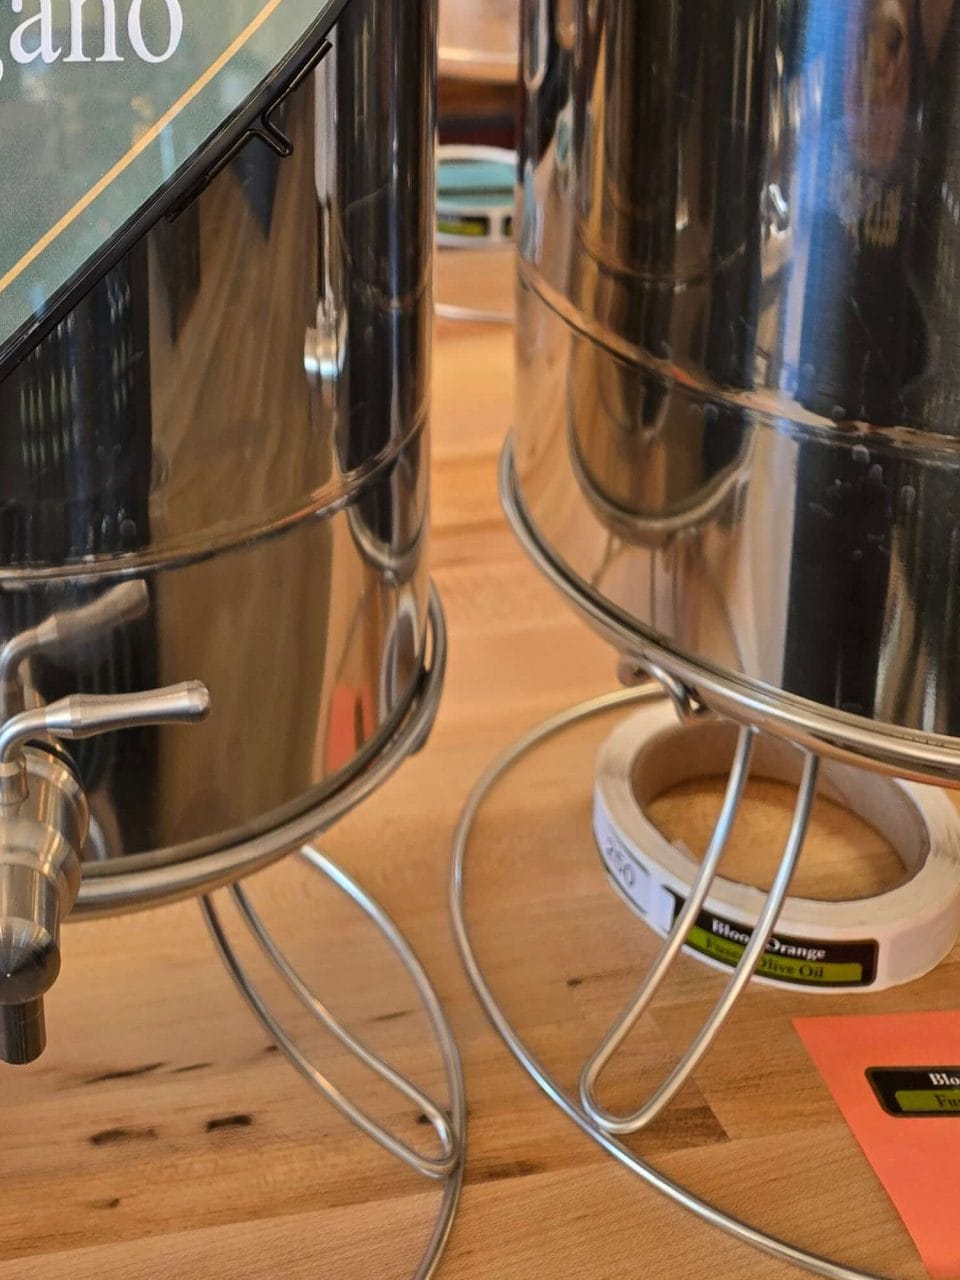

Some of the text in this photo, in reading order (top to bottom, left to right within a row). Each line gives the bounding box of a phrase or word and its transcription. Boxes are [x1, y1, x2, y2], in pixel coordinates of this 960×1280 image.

[712, 919, 827, 961] Bloo Orange
[798, 963, 824, 978] Oil
